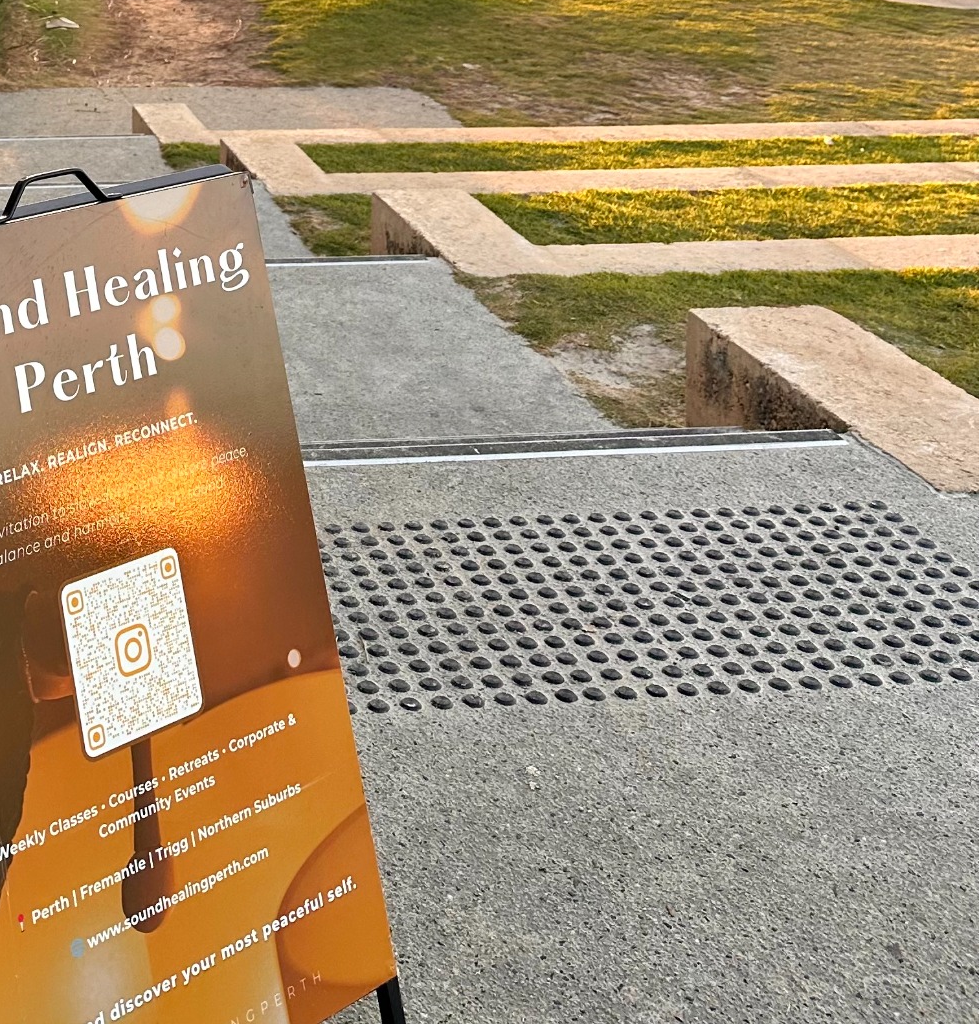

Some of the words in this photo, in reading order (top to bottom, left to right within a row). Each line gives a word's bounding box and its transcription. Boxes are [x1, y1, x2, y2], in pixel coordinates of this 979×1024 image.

[63, 242, 250, 318] Healing
[15, 333, 158, 414] Perth
[47, 437, 111, 470] REALIGN.
[114, 412, 198, 448] RECONNECT.
[44, 527, 70, 550] and
[52, 505, 66, 520] to
[49, 805, 99, 837] Classes
[108, 776, 159, 809] Courses
[168, 749, 220, 781] Retreats
[228, 720, 286, 754] Corporate
[287, 713, 297, 726] &
[98, 794, 173, 839] Community
[174, 774, 216, 803] Events
[31, 895, 70, 925] Perth
[79, 857, 147, 901] Fremantle
[154, 836, 189, 862] Trigg
[197, 805, 252, 842] Northern
[254, 782, 302, 815] Suburbs
[86, 846, 270, 949] www.soundhealingperth.com
[109, 973, 179, 1022] discover
[181, 951, 218, 986] your
[220, 930, 260, 961] most
[262, 892, 325, 941] peaceful
[327, 874, 358, 904] self.
